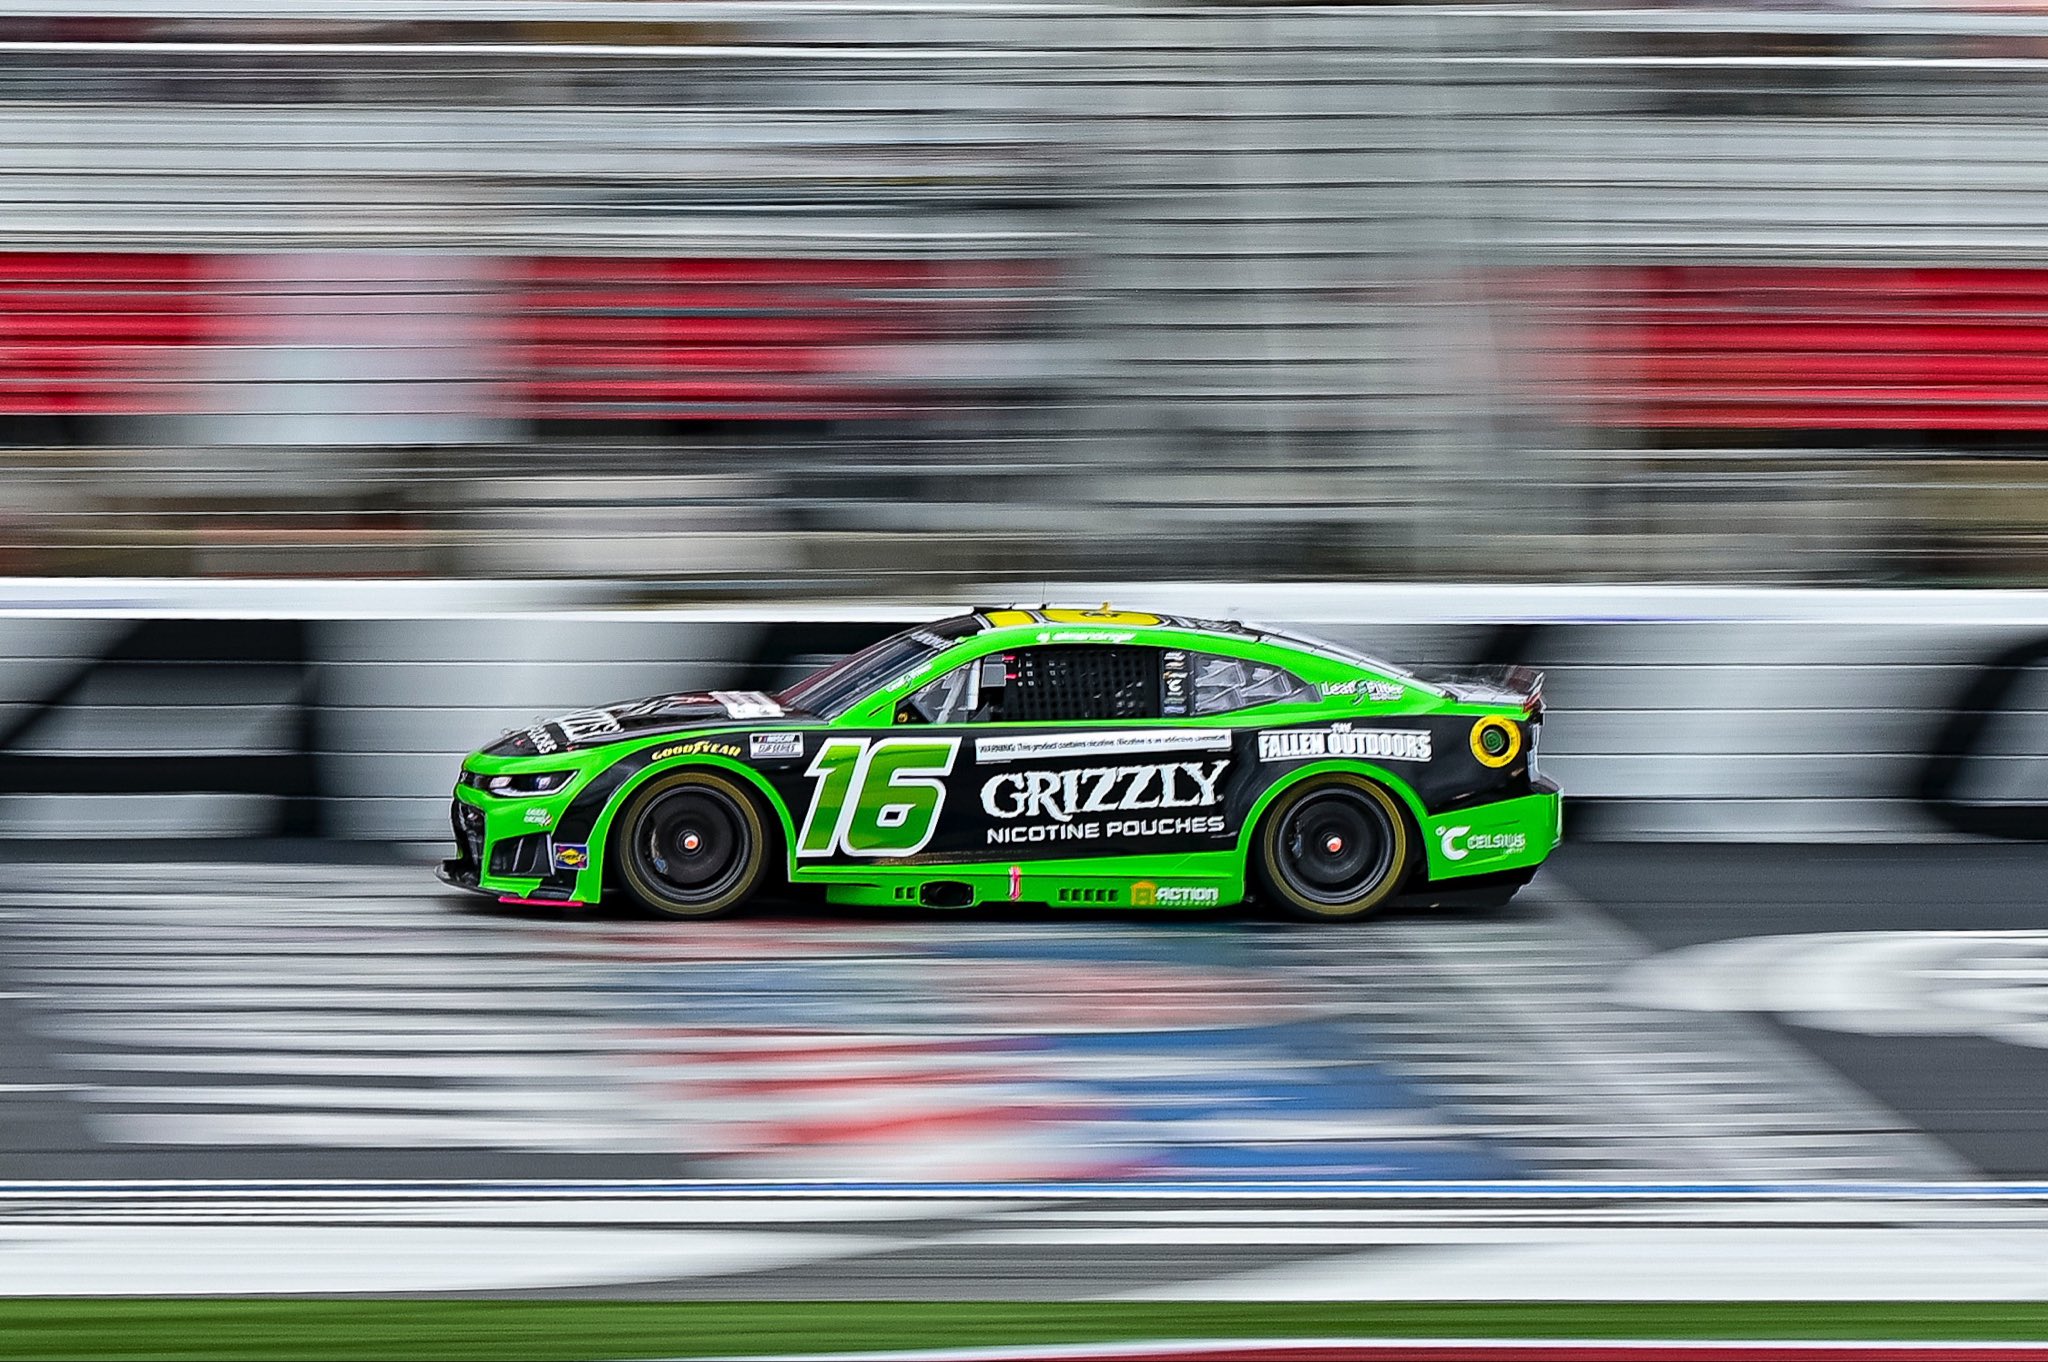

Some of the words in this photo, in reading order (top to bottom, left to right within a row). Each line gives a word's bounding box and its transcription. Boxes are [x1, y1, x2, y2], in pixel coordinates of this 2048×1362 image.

[651, 740, 741, 761] GOODYEAR
[1258, 733, 1325, 759] FALLEN
[1327, 733, 1432, 759] OUTDOORS
[796, 737, 963, 857] 16
[979, 759, 1230, 822] GRIZZLY
[986, 822, 1100, 844] NICOTINE
[1106, 816, 1225, 838] POUCHES
[1467, 832, 1526, 850] CELSIUS
[1156, 886, 1219, 900] ACTION
